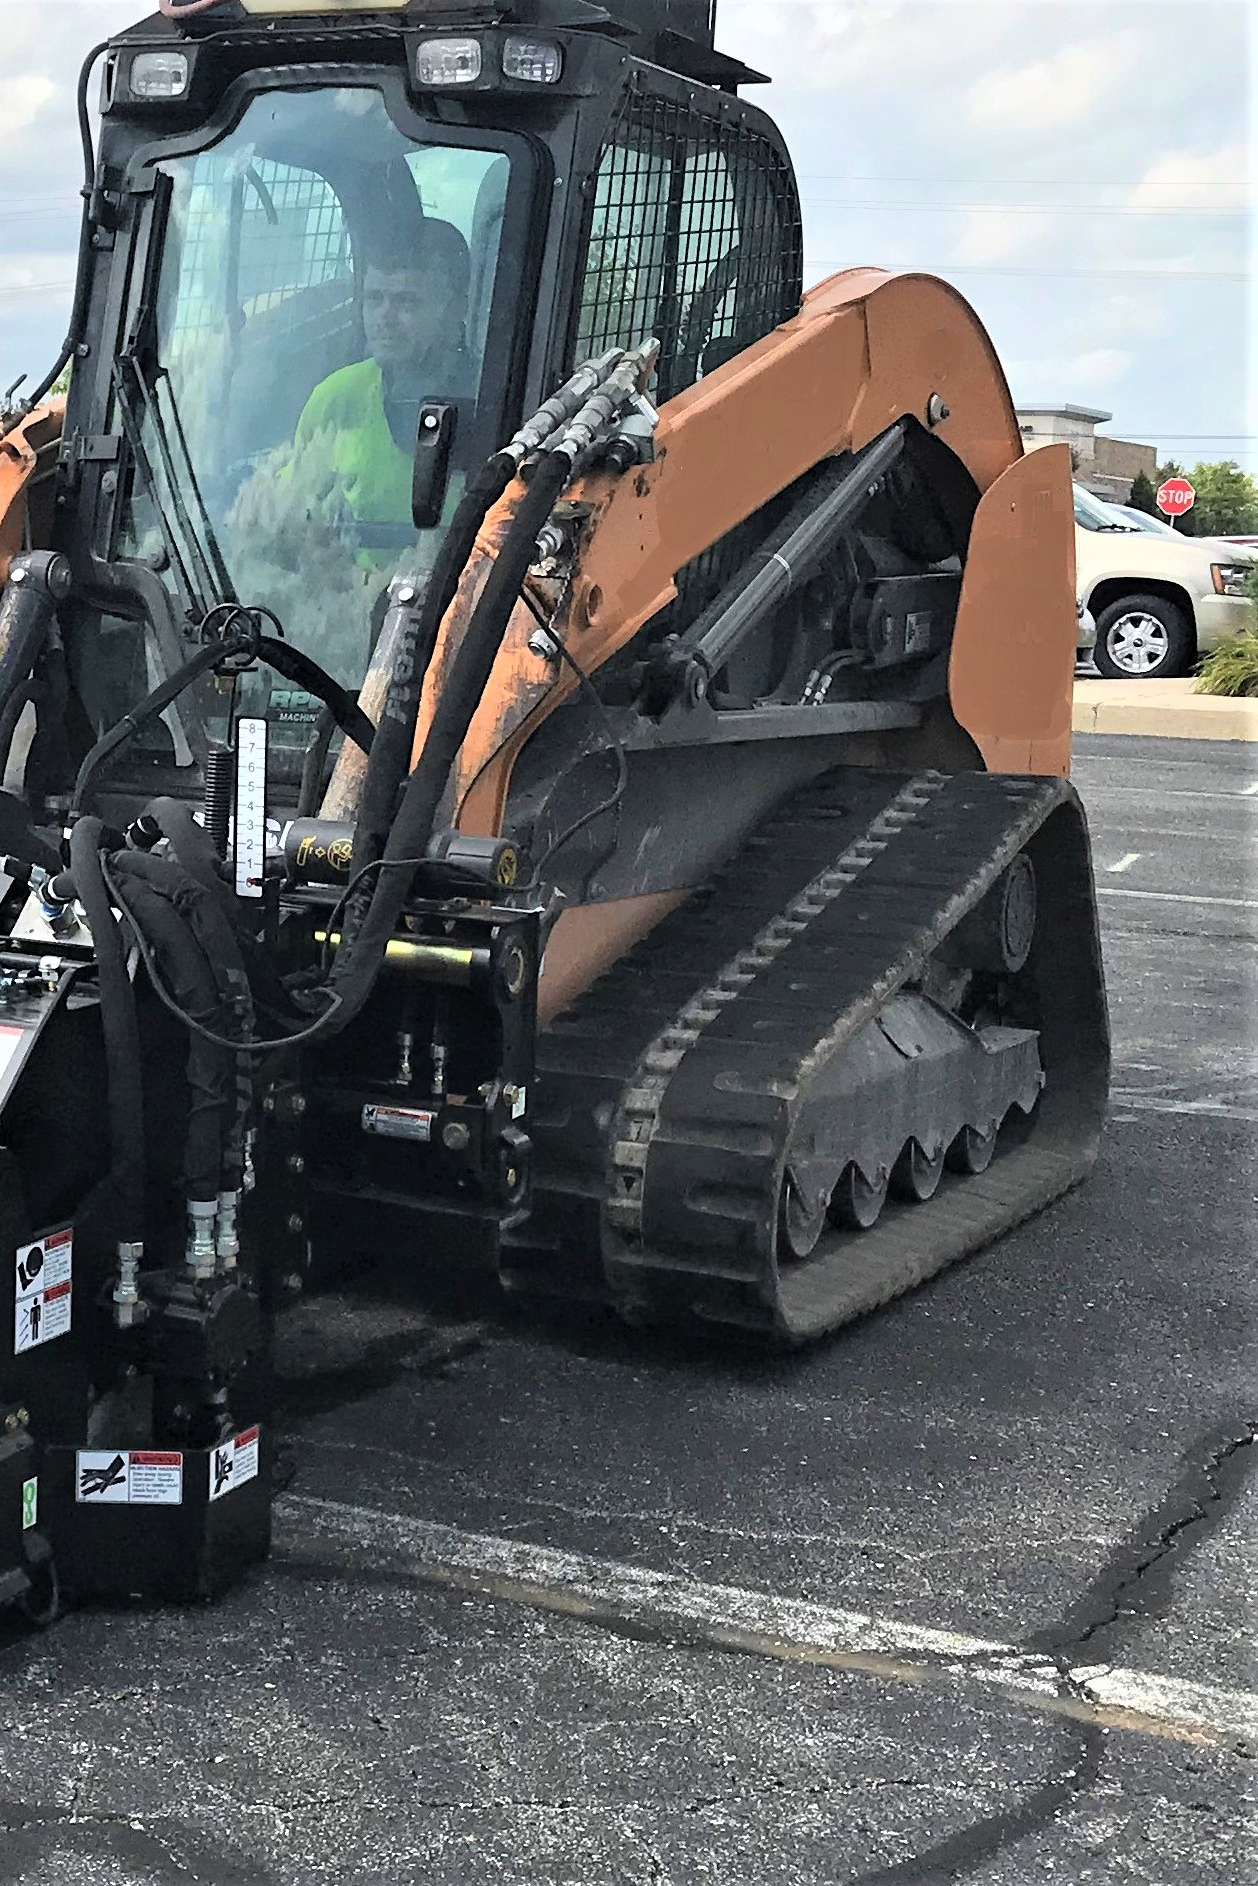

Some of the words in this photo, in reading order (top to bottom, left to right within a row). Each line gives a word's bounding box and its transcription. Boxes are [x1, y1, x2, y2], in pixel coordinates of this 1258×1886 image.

[1158, 489, 1193, 505] STOP
[279, 712, 320, 722] MACHIN
[248, 723, 256, 734] 8
[248, 743, 255, 753] 7
[248, 762, 255, 773] 6
[247, 781, 255, 792] 5
[247, 800, 254, 811] 4
[246, 819, 254, 831] 3
[246, 839, 253, 850] 2
[247, 858, 252, 869] 1
